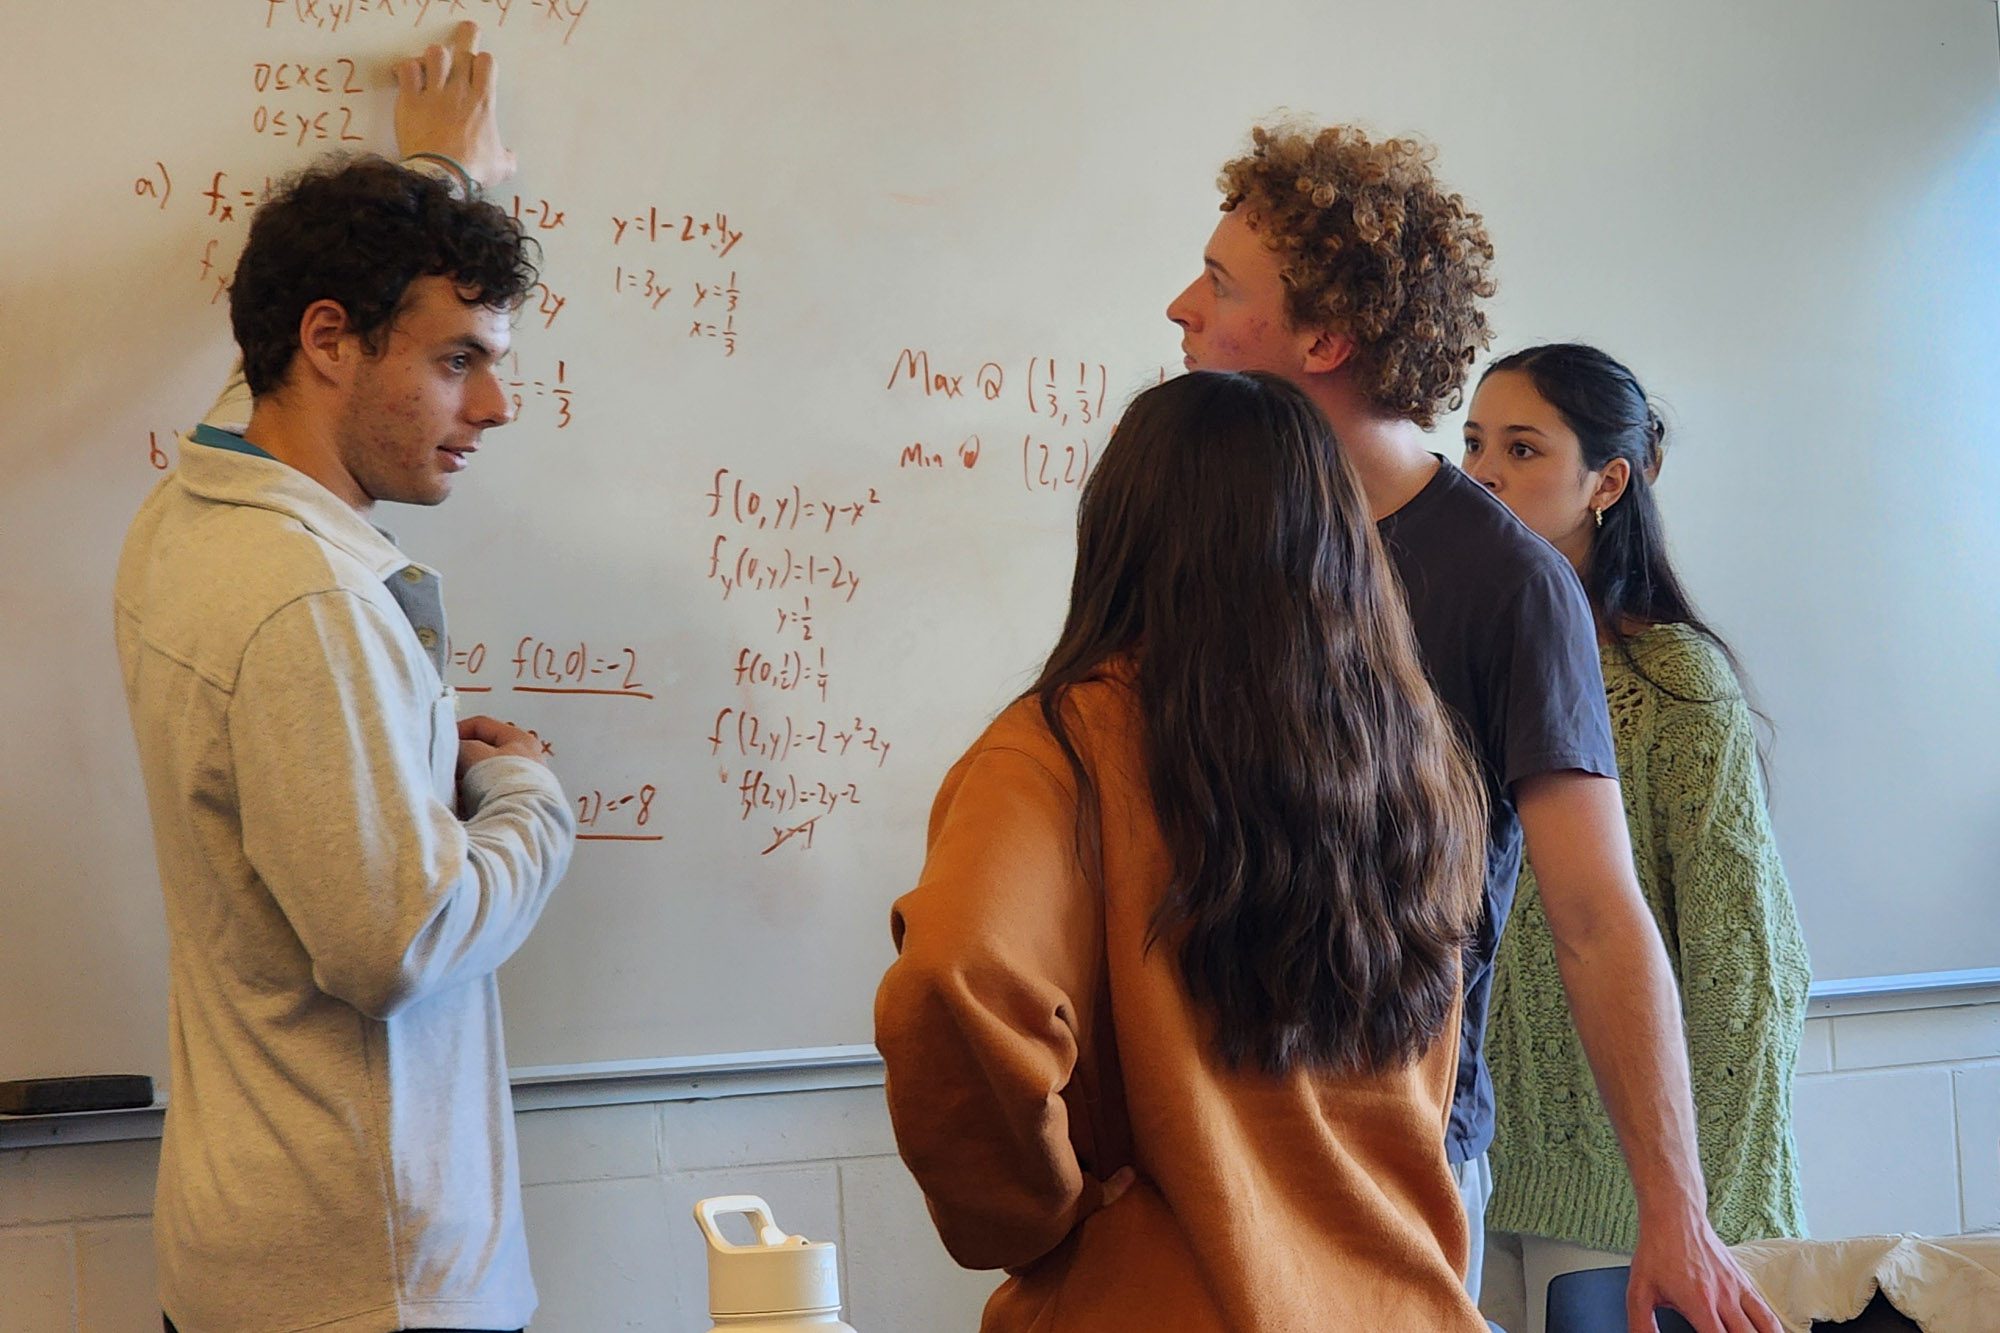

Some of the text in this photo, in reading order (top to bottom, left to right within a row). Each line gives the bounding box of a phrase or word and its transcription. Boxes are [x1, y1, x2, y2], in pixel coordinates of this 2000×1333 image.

[135, 161, 171, 210] a)
[887, 348, 963, 398] Max
[150, 432, 179, 469] b
[901, 443, 943, 468] Min
